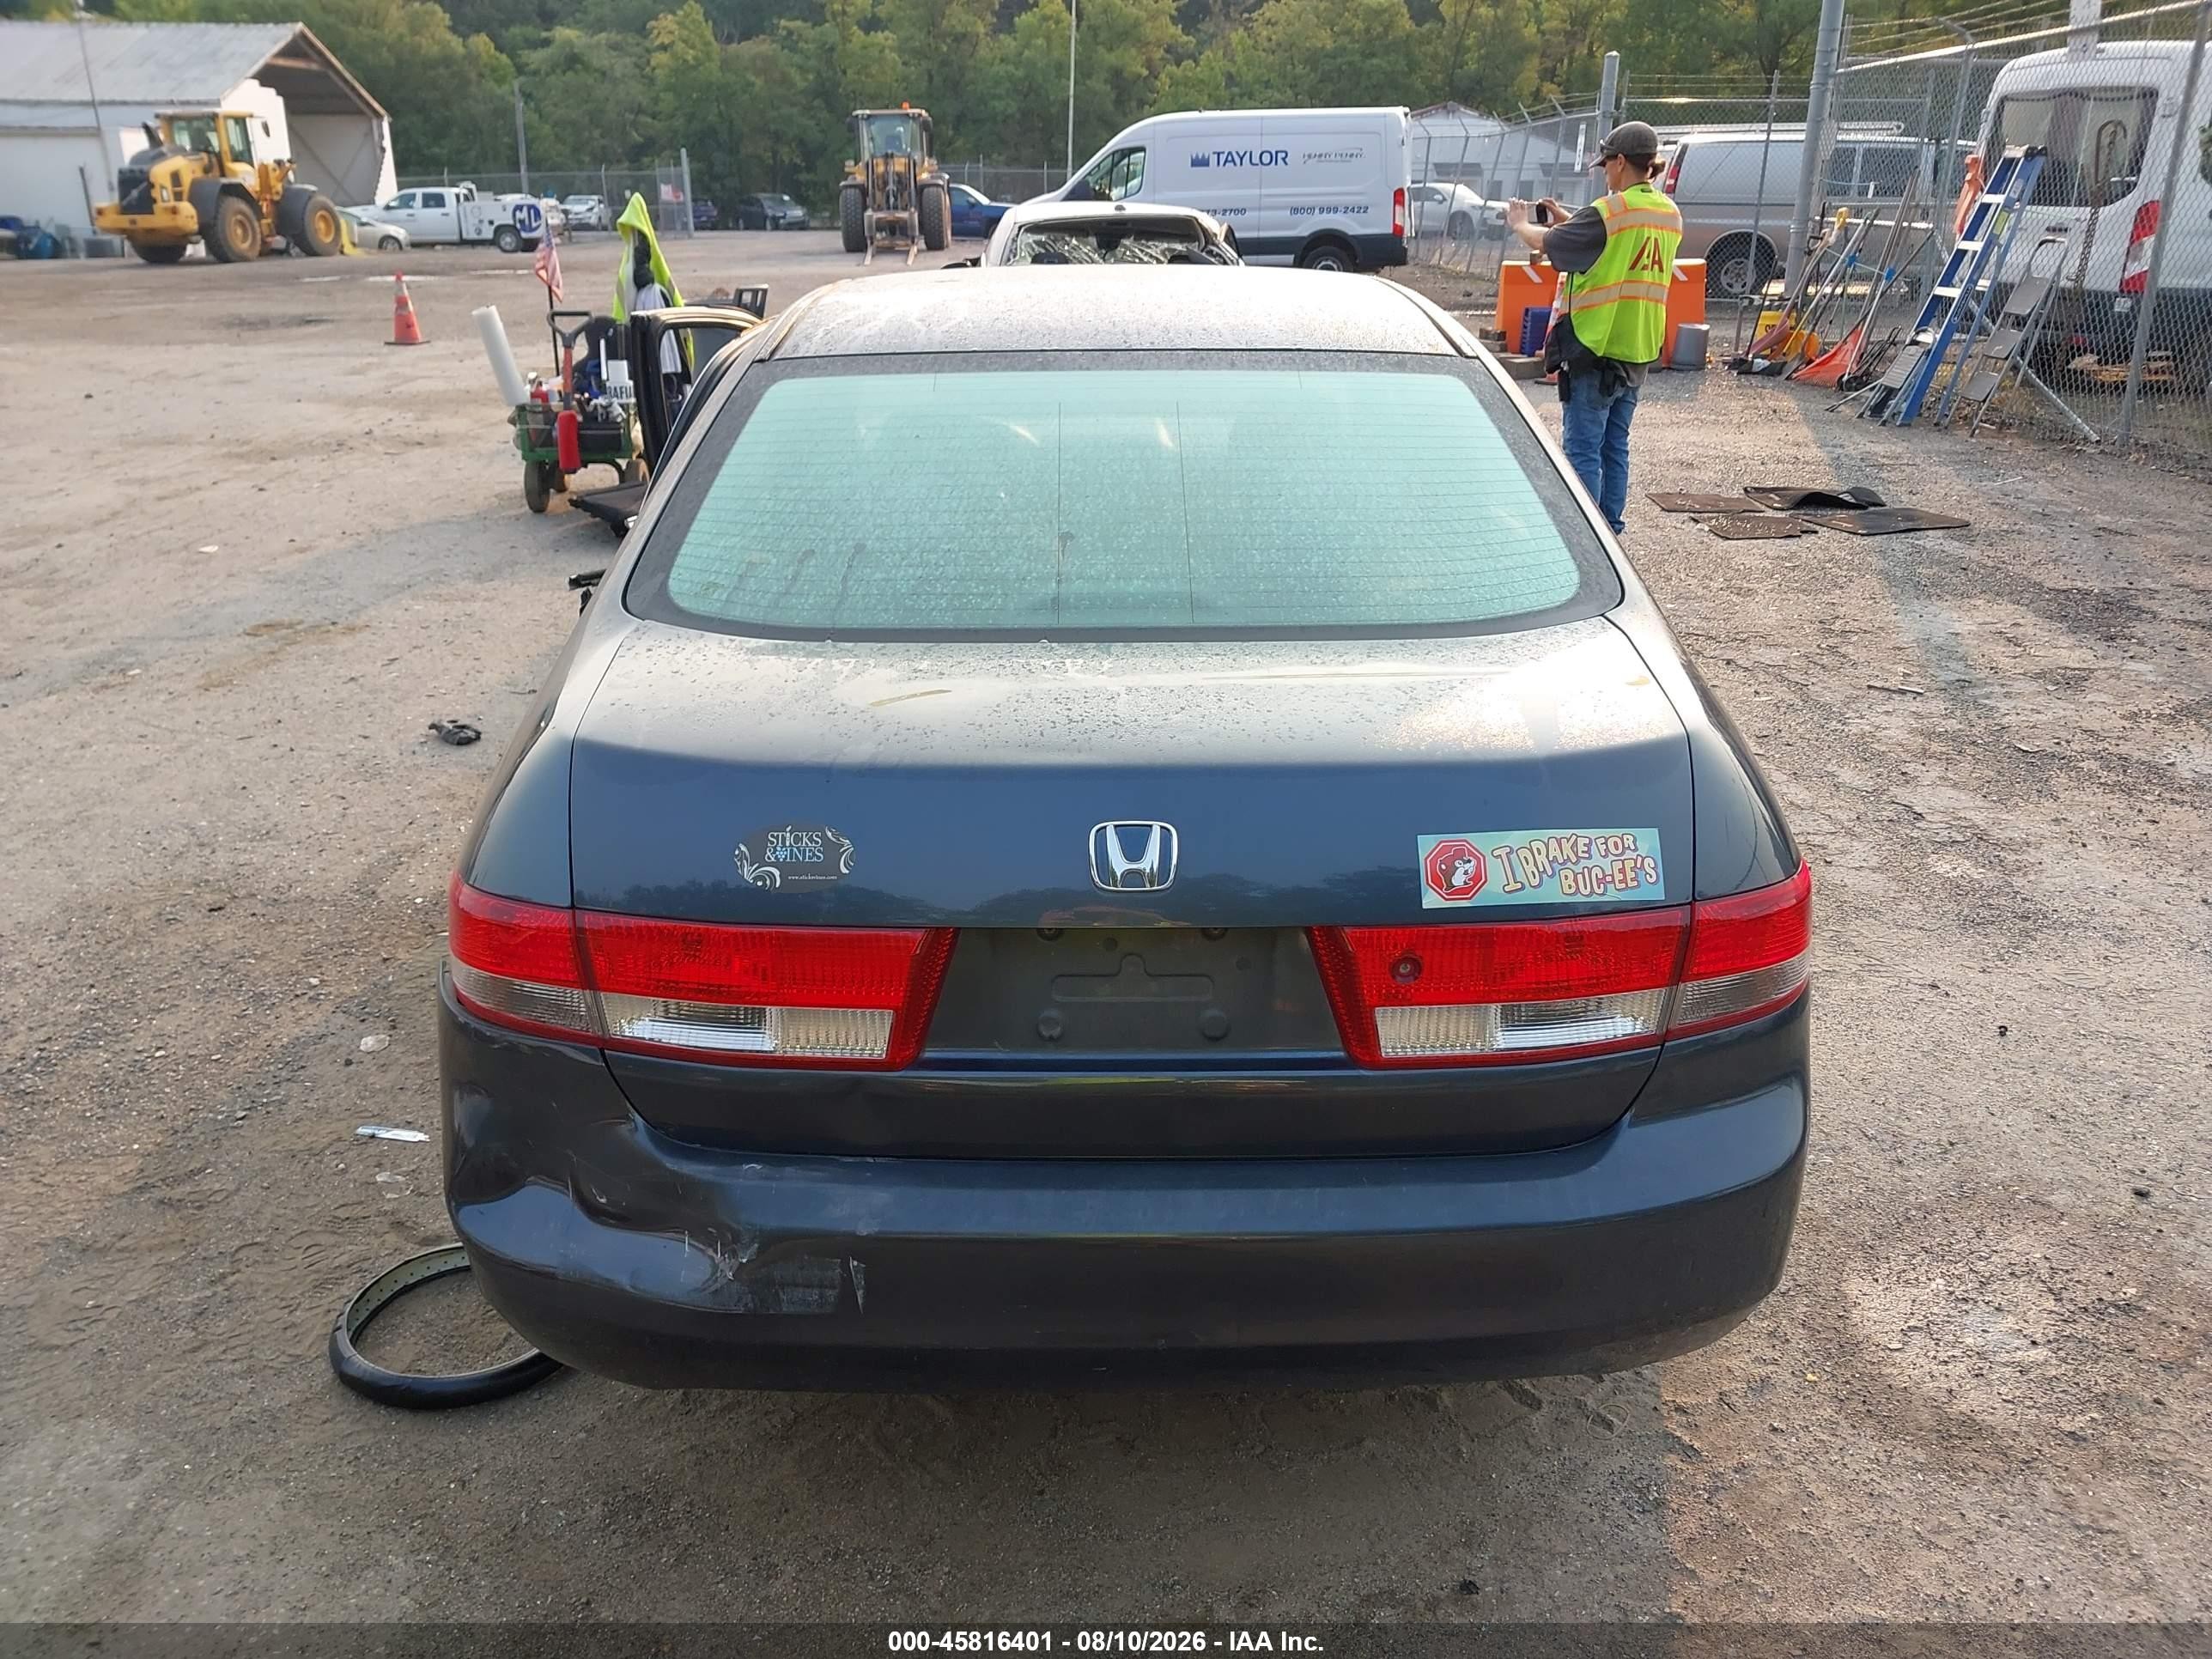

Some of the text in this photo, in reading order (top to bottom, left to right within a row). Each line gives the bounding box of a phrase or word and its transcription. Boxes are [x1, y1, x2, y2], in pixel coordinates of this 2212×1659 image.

[1212, 149, 1289, 167] TAYLOR
[1290, 206, 1316, 216] (800)
[1319, 205, 1370, 215] 999-2422
[767, 825, 822, 848] STICKS
[1492, 833, 1638, 893] I BRAKE FOR
[1559, 855, 1659, 896] BUC-EE'S
